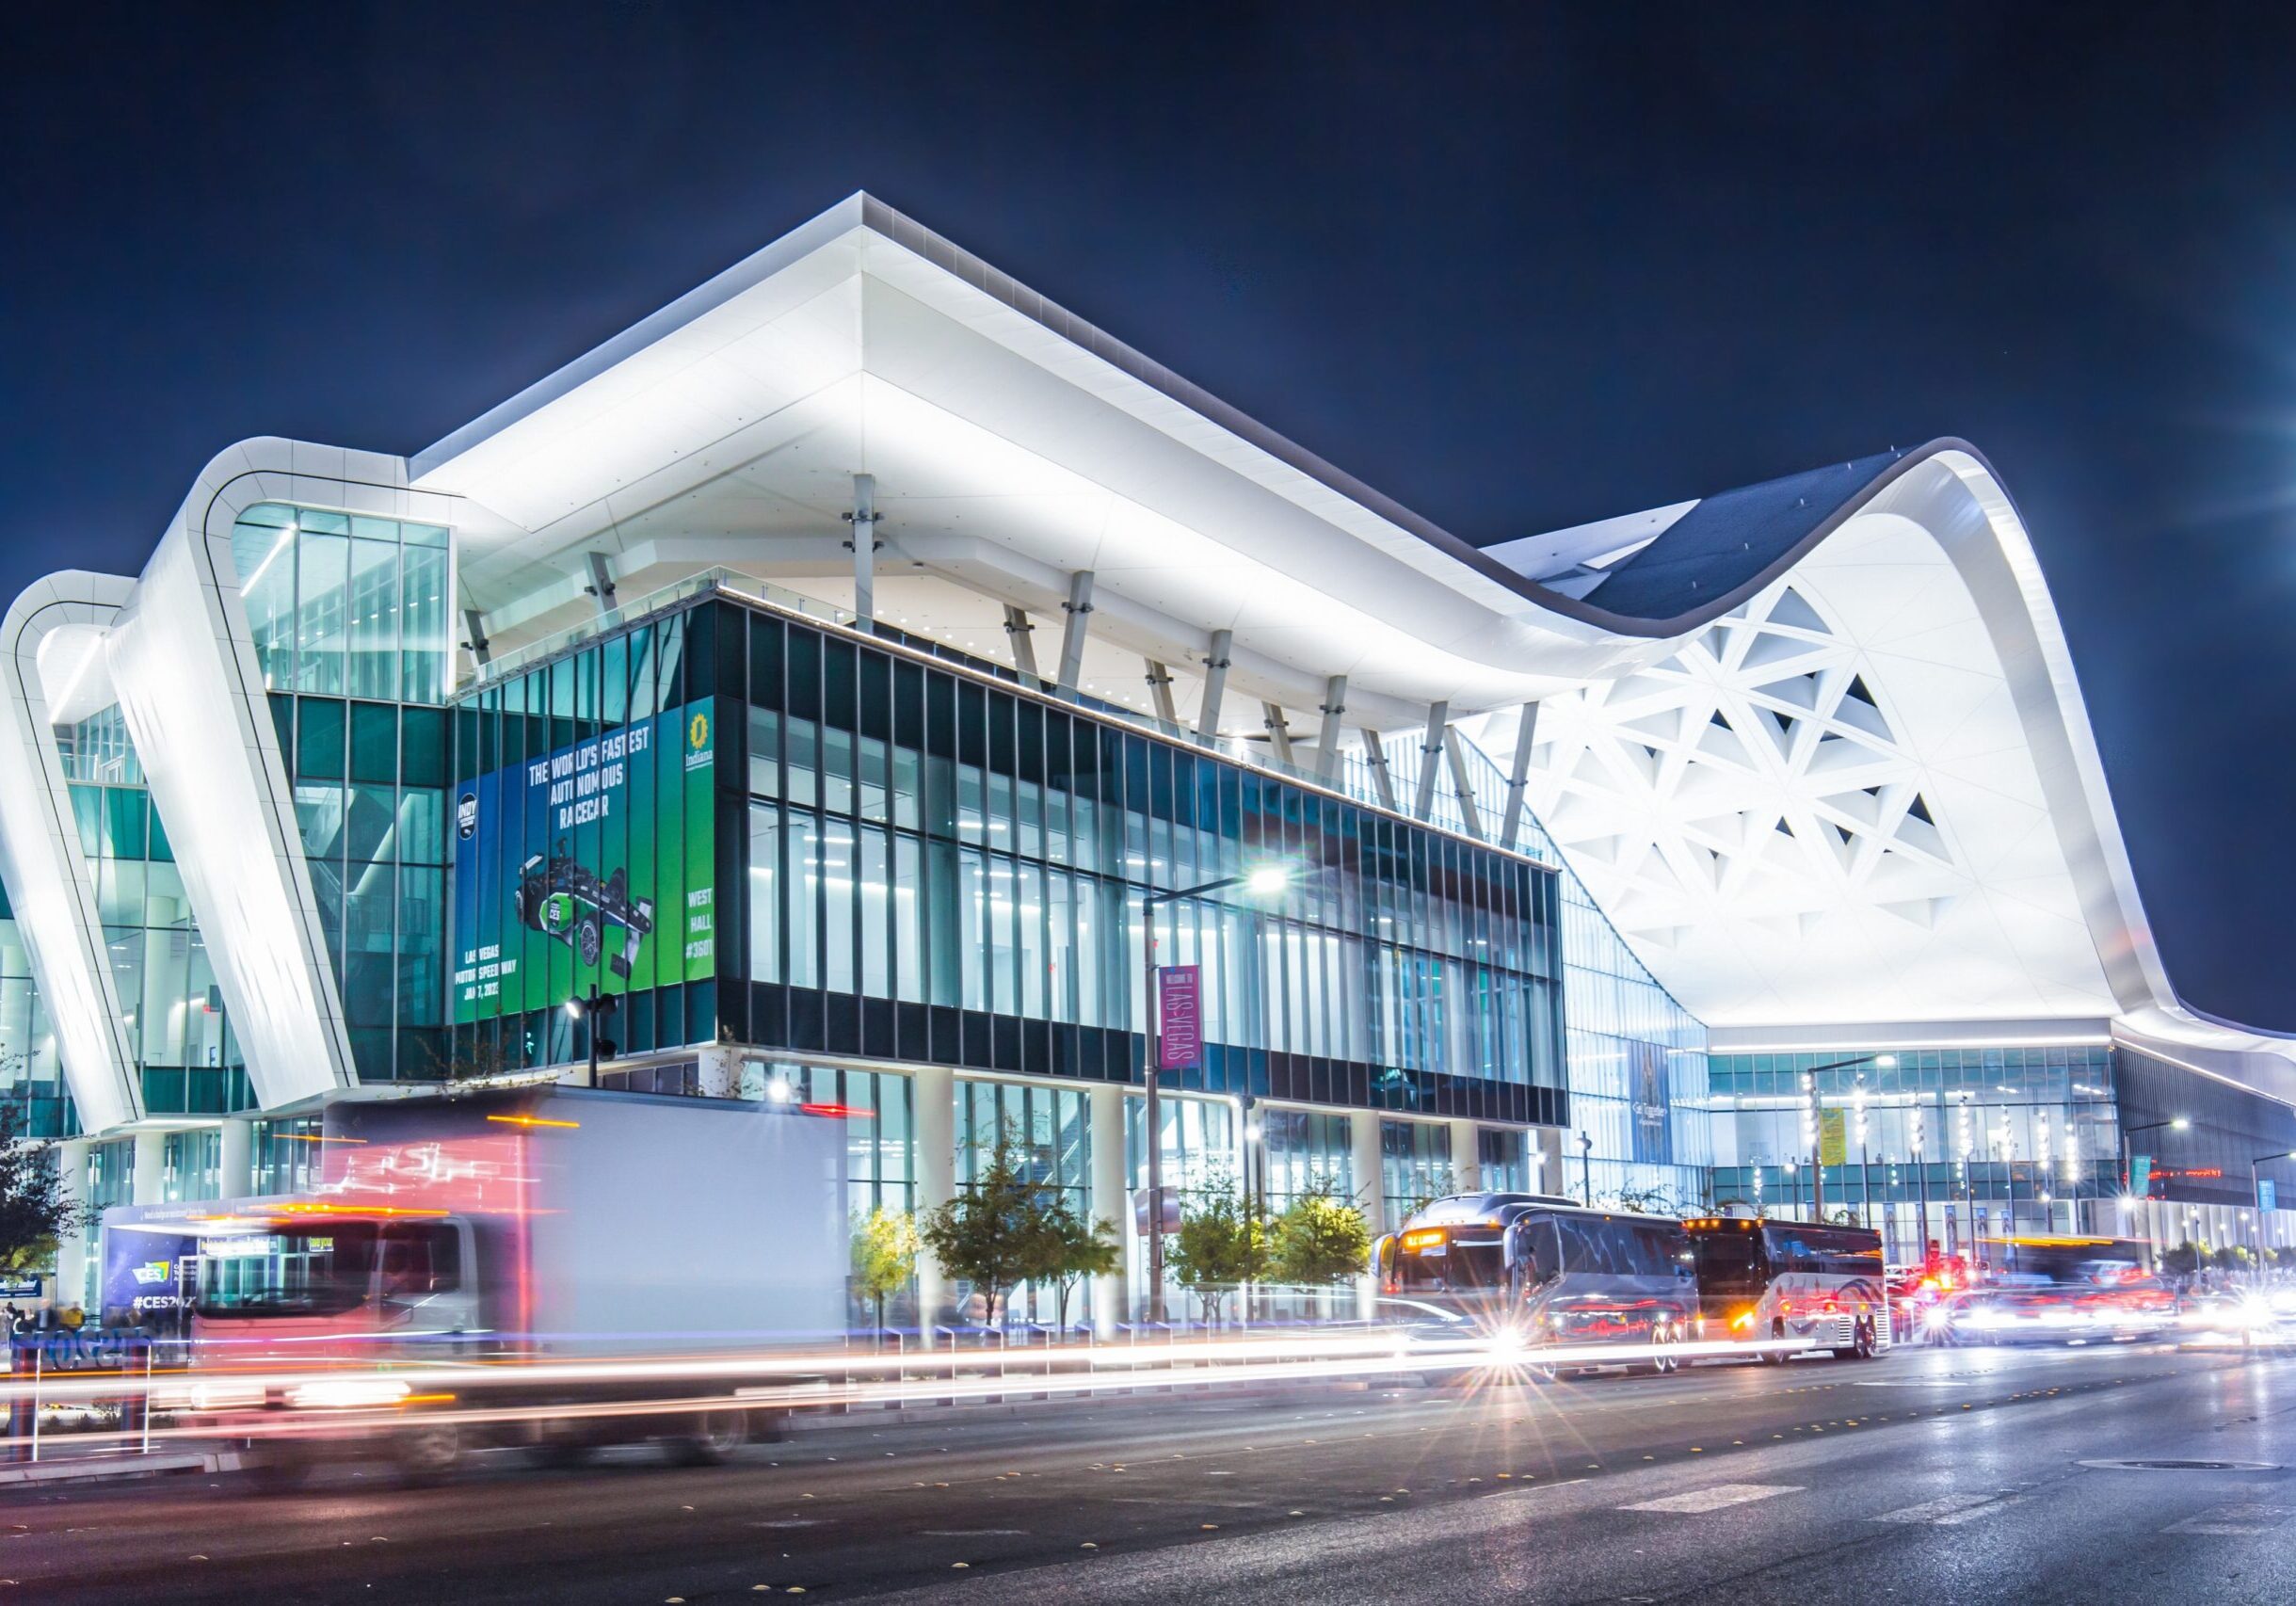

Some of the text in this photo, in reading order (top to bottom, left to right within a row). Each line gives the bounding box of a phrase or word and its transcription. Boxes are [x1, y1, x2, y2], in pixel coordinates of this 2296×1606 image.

[529, 762, 549, 787] THE
[602, 727, 650, 763] FASTEST
[685, 749, 713, 766] Indiana
[458, 799, 477, 819] INDY
[559, 795, 609, 829] RACECAR
[688, 888, 713, 907] WEST
[690, 914, 712, 933] HALL
[478, 944, 499, 960] VEGAS
[685, 939, 713, 959] #3601
[1166, 985, 1195, 1060] LAS VEGAS
